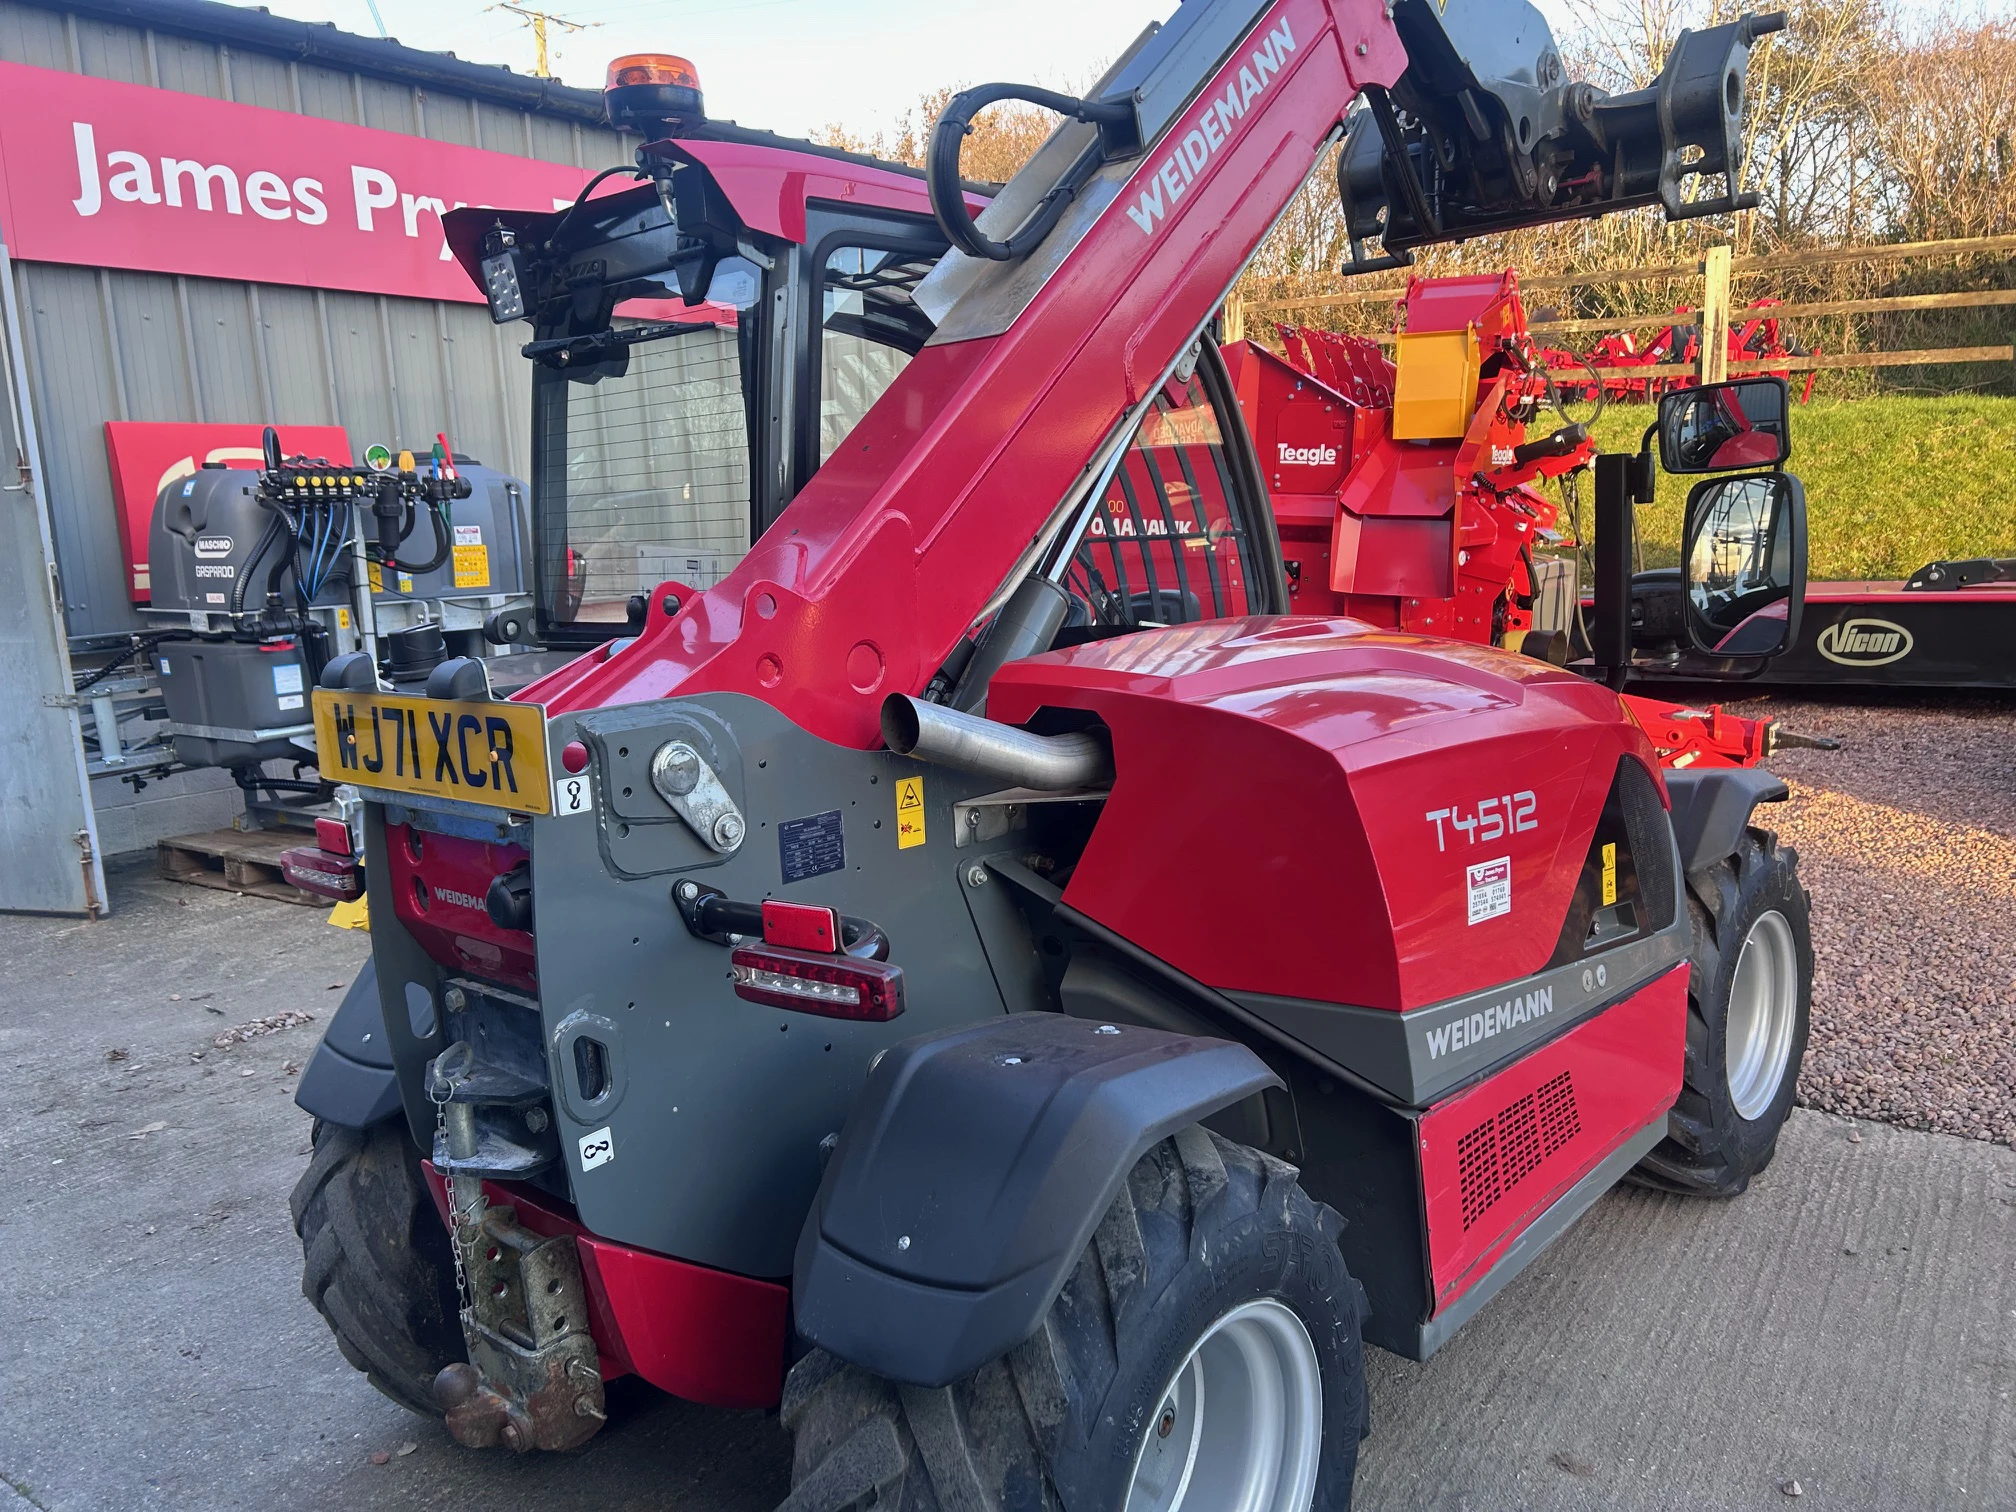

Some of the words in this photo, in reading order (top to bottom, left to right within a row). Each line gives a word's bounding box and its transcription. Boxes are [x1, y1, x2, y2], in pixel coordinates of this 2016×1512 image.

[1126, 16, 1296, 236] WEIDEMANN
[71, 121, 329, 226] James
[350, 165, 497, 262] Pry
[1277, 442, 1337, 467] Teagle
[198, 539, 232, 551] MASCHIO
[195, 565, 235, 578] GASPARDO
[1830, 622, 1902, 654] Vicon
[333, 702, 422, 780] WJ71
[427, 711, 519, 794] XCR
[1425, 789, 1539, 853] T4512
[433, 886, 488, 913] WEIDEMA
[1425, 985, 1553, 1060] WEIDEMANN
